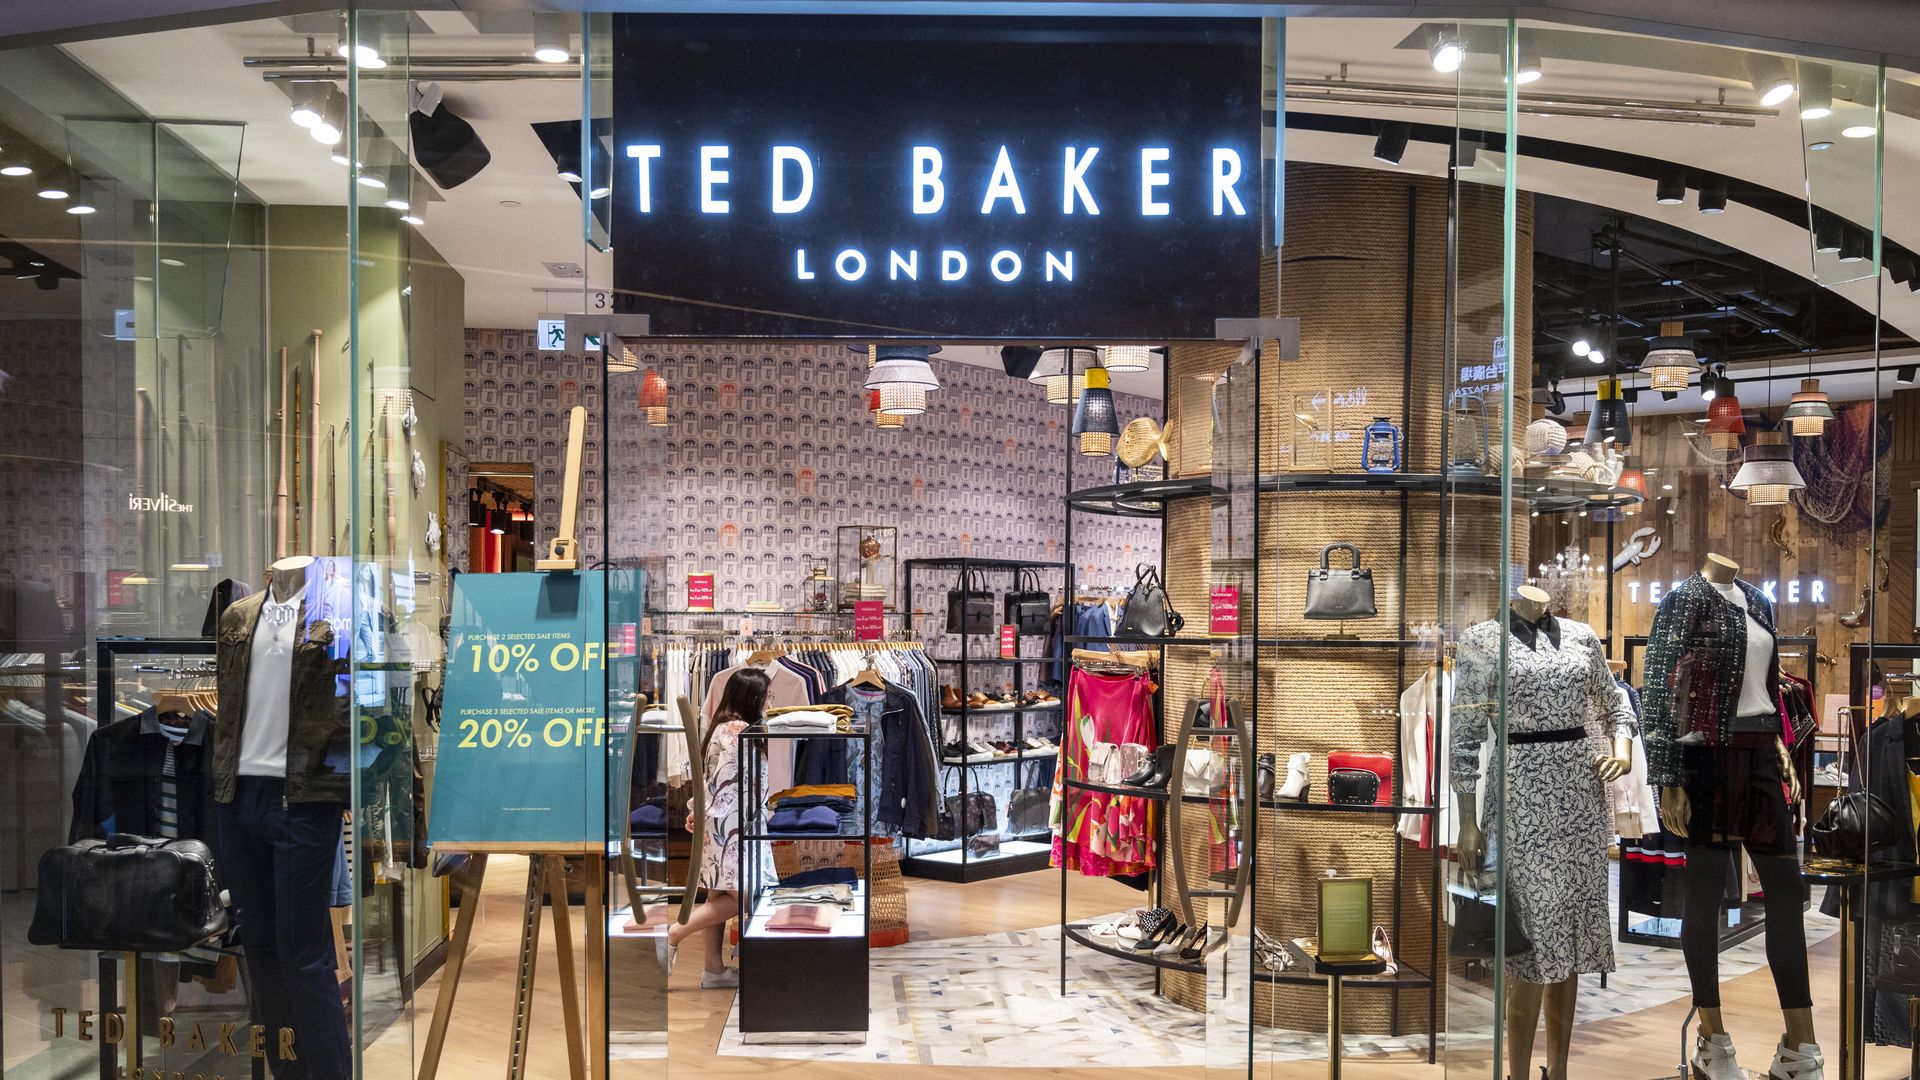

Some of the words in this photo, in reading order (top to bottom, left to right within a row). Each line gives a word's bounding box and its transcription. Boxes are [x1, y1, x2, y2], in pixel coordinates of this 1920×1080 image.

[626, 144, 814, 214] TED
[912, 144, 1247, 215] BAKER
[797, 249, 1073, 282] LONDON
[1628, 581, 1682, 604] TE
[468, 633, 500, 641] PURCHASE
[501, 633, 506, 641] 2
[536, 632, 551, 640] SALE
[552, 632, 571, 640] ITEMS
[471, 642, 540, 673] 10%
[550, 642, 620, 672] OFF
[460, 708, 494, 716] PURCHASE
[545, 707, 564, 715] ITEMS
[576, 706, 596, 714] MORE
[457, 718, 532, 748] 20%
[543, 717, 614, 748] OFF
[51, 1007, 125, 1045] TED
[159, 1015, 298, 1062] BAKER
